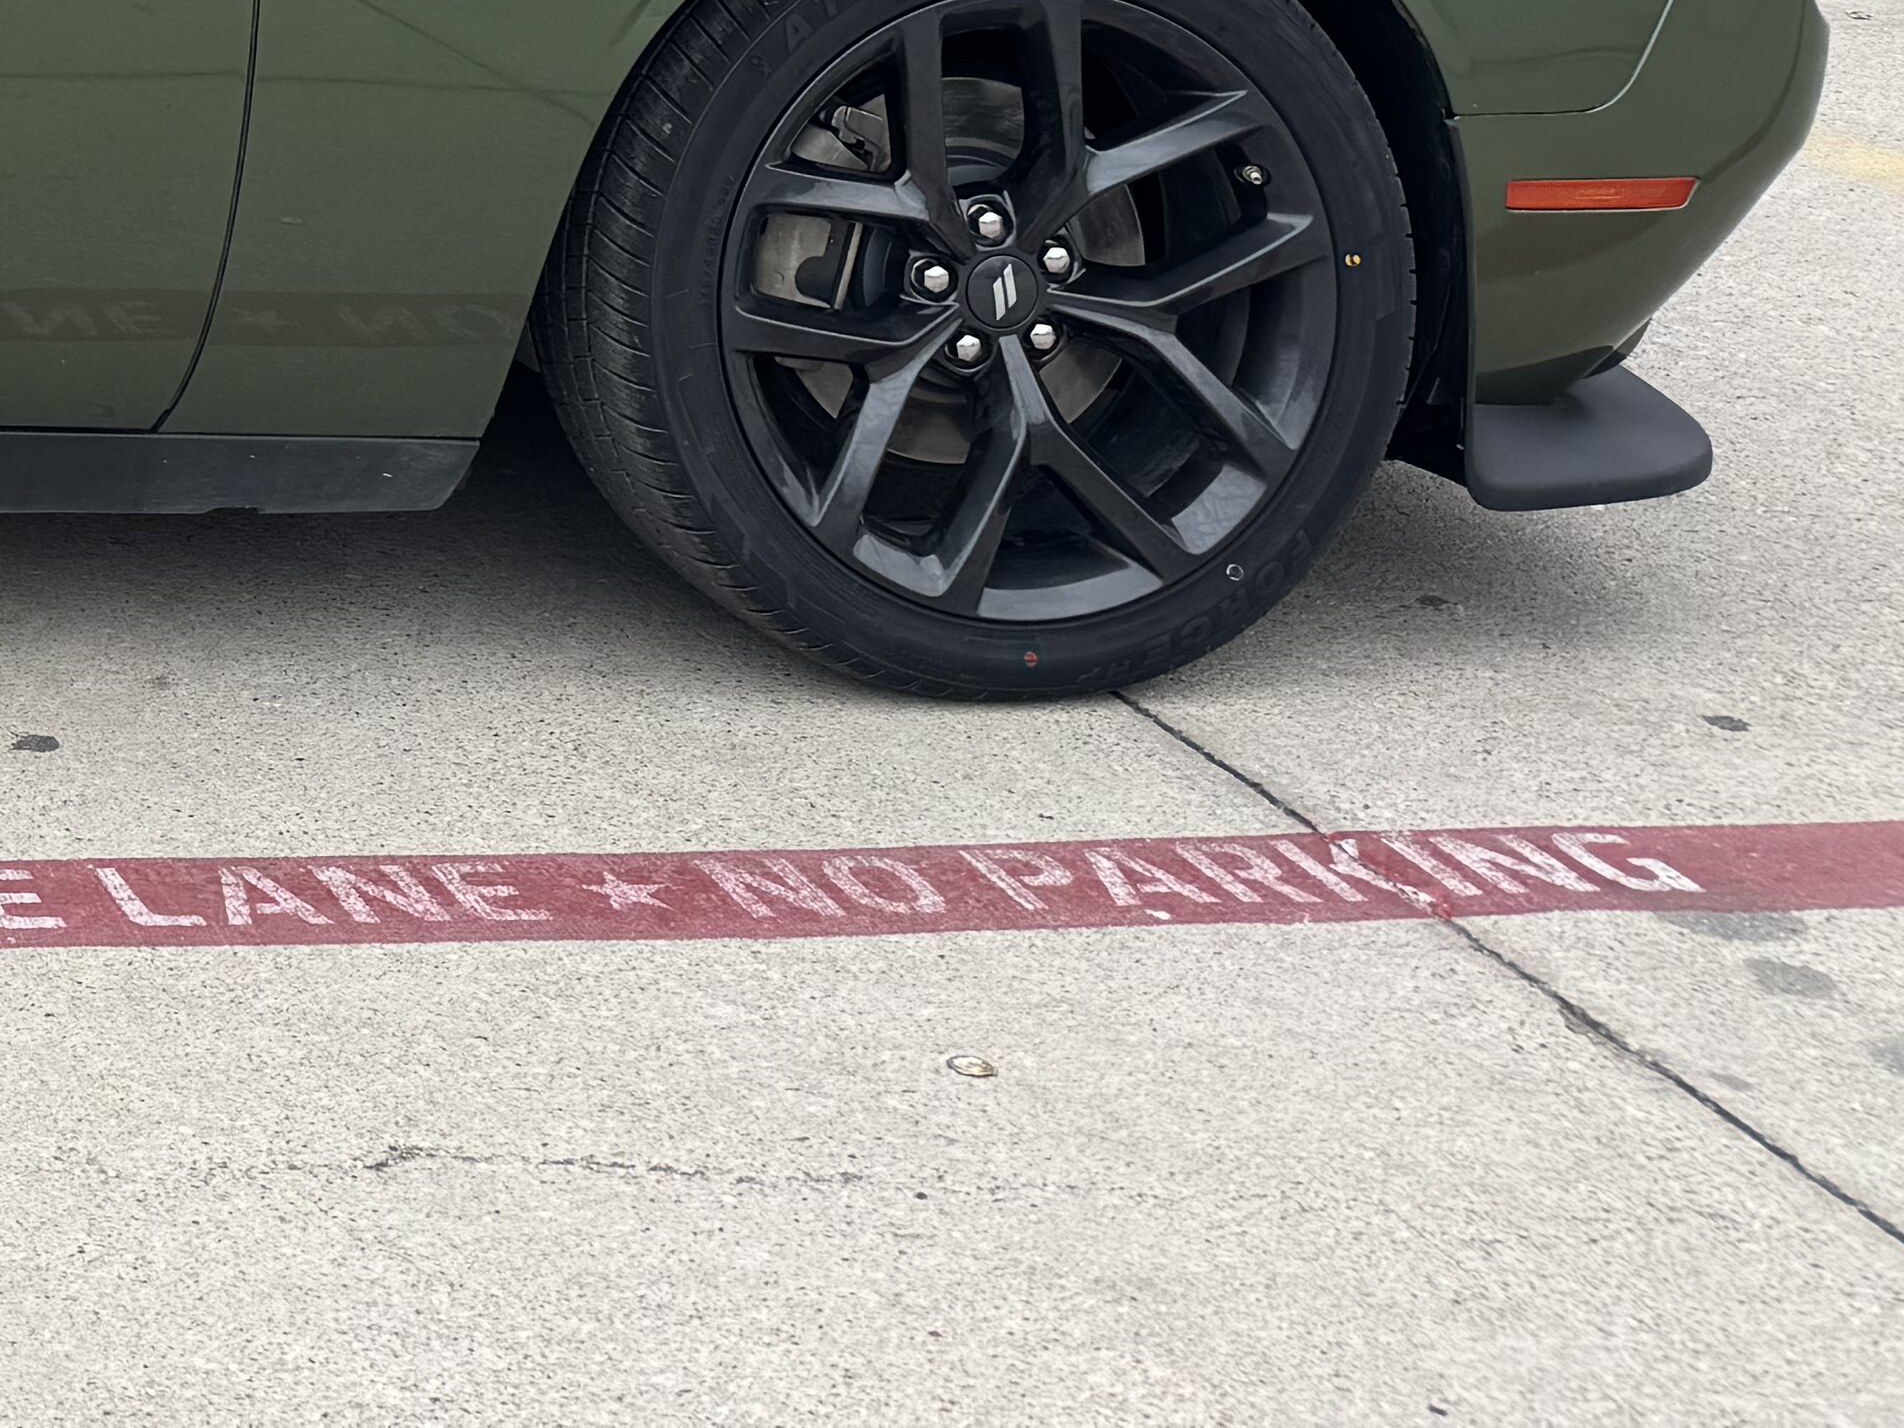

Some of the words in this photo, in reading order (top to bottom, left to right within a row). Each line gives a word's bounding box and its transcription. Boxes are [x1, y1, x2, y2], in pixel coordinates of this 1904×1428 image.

[94, 861, 553, 930] LANE
[687, 854, 948, 920] NO
[958, 832, 1709, 911] PARKING
